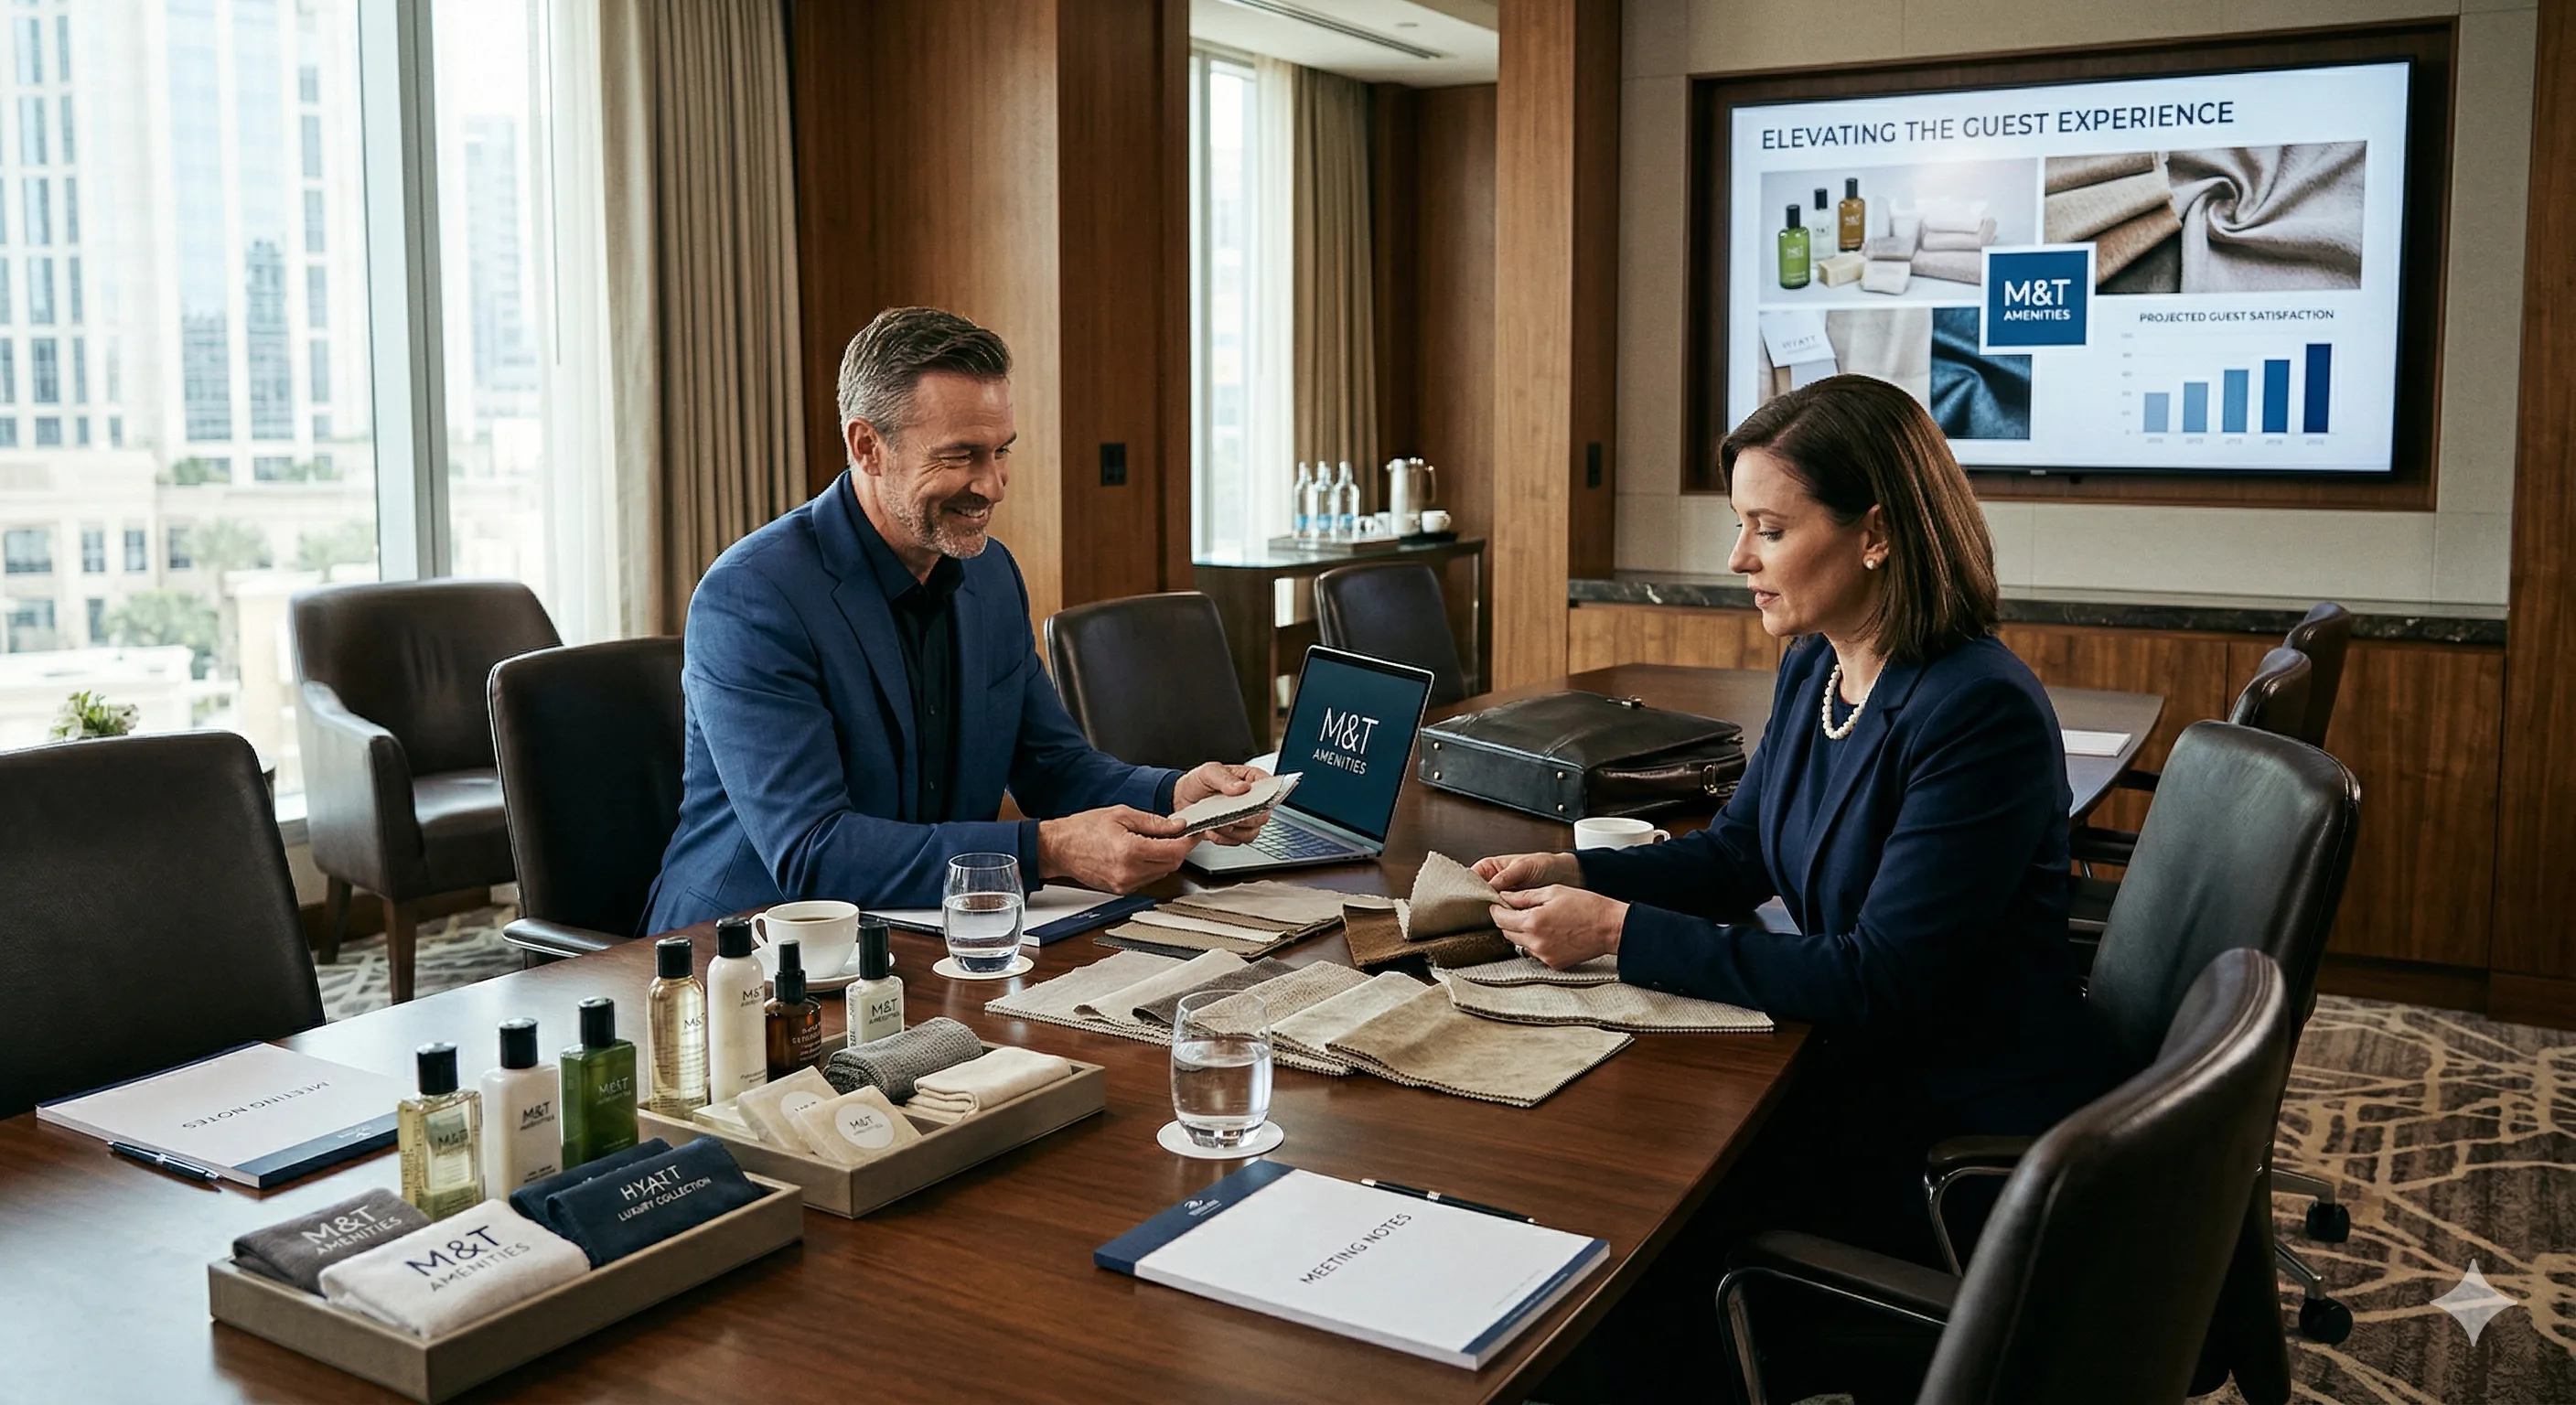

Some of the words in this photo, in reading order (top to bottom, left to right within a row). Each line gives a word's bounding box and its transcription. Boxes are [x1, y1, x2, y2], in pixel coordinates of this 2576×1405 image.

[1762, 123, 1895, 149] ELEVATING
[1905, 119, 1954, 141] THE
[1963, 113, 2049, 137] GUEST
[2058, 102, 2234, 133] EXPERIENCE
[2004, 278, 2071, 306] M&T
[2003, 309, 2071, 321] AMENITIES
[2140, 312, 2206, 323] PROJECTED
[2209, 311, 2247, 322] GUEST
[2250, 309, 2334, 321] SATISFACTION
[1318, 707, 1379, 755] M&T
[1312, 748, 1368, 775] AMENITIES
[872, 998, 897, 1016] M&T
[250, 1081, 330, 1109] MEETING
[182, 1106, 248, 1129] NOTES
[620, 1164, 682, 1200] HYATT
[657, 1176, 712, 1206] COLLECTION
[301, 1205, 376, 1244] M&T
[317, 1216, 402, 1256] AMENITIES
[405, 1225, 499, 1277] M&T
[1299, 1242, 1368, 1284] MEETING
[1362, 1213, 1411, 1244] NOTES
[429, 1242, 531, 1292] AMENITIES
